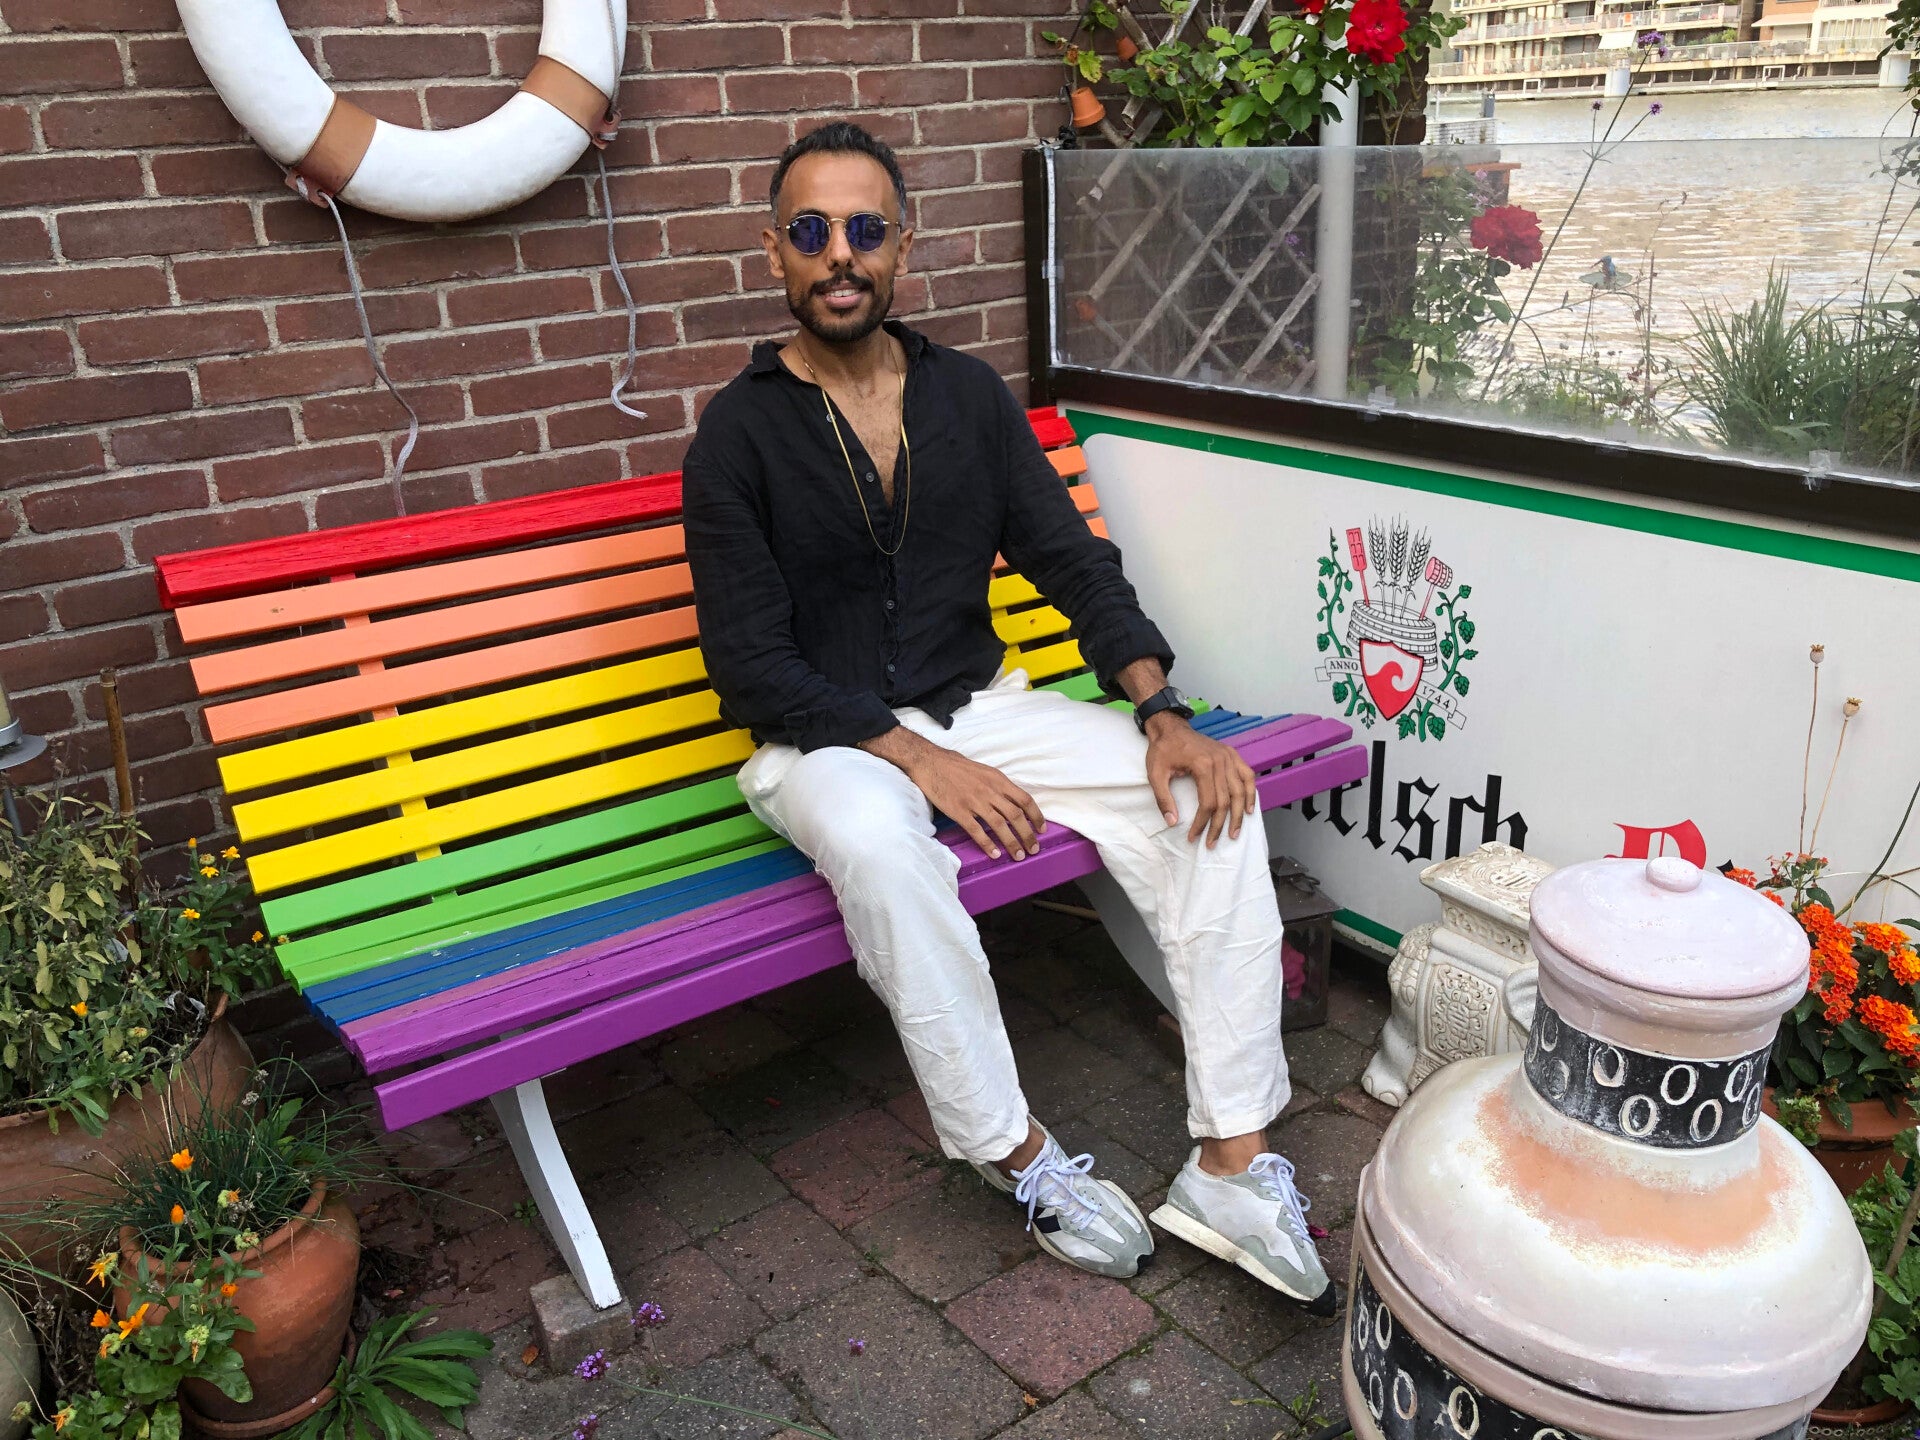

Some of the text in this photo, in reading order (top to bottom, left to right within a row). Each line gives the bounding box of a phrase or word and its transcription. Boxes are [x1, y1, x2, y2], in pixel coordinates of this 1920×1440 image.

[1330, 660, 1450, 709] ANNO 1744
[1261, 740, 1528, 863] elsch
